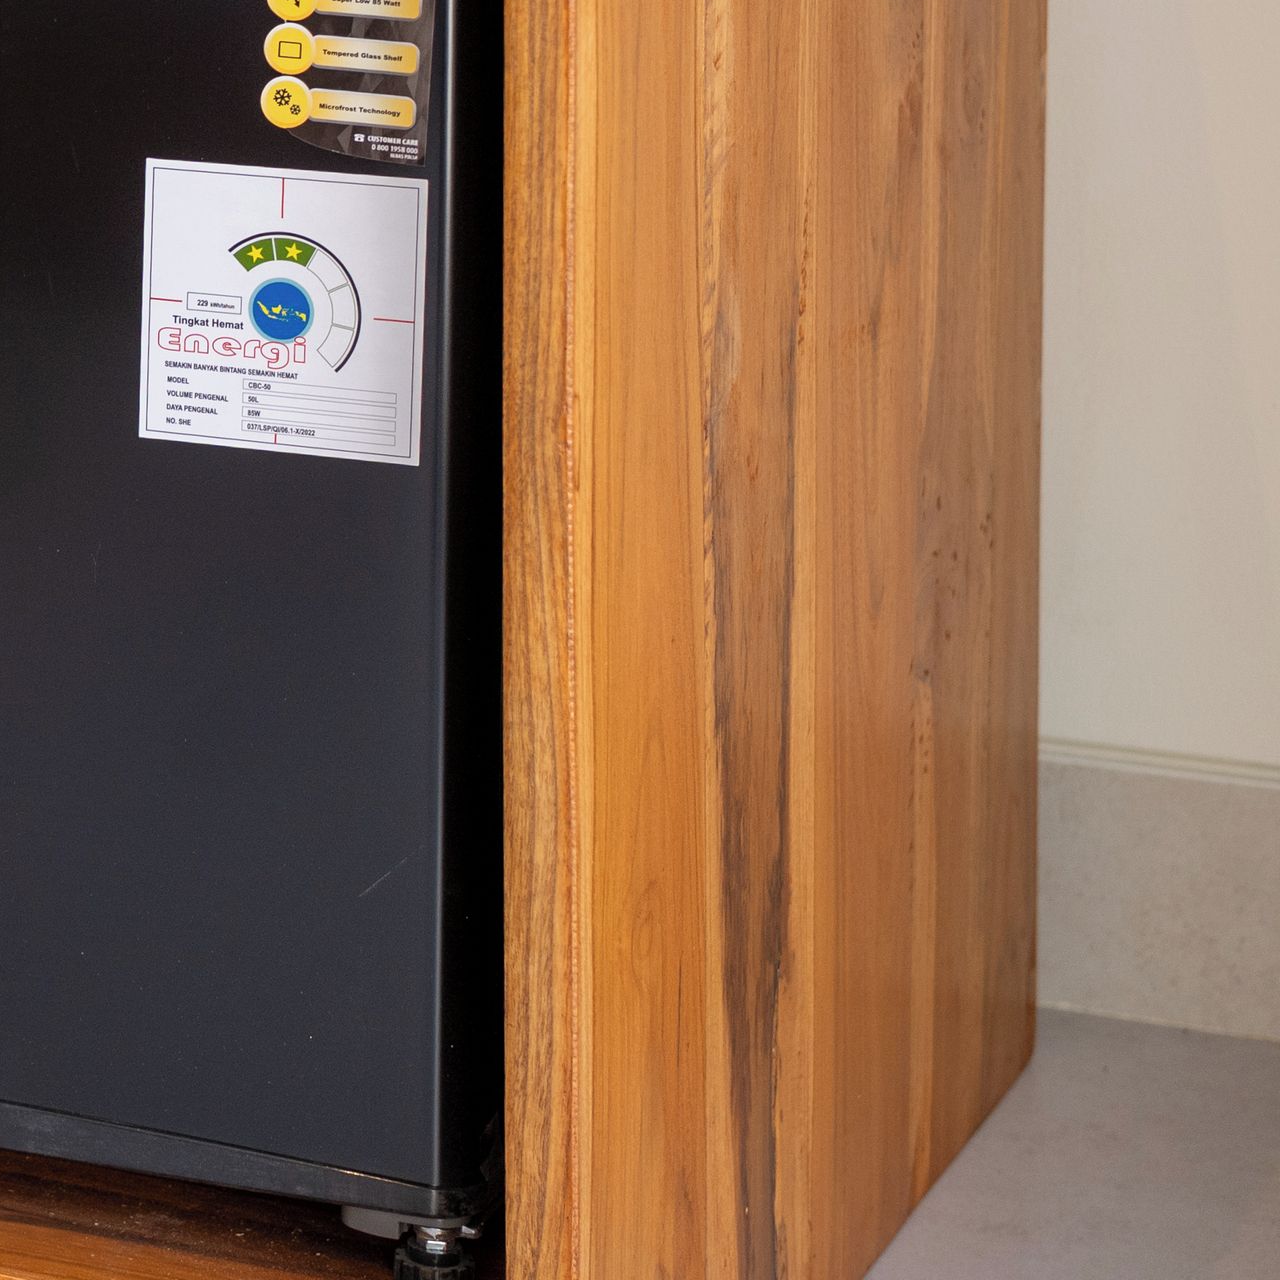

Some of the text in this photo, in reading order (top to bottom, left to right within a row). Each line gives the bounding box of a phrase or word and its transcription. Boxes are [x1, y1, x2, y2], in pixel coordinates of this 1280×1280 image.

[323, 49, 403, 62] Tempered Glass Shelf
[319, 103, 401, 118] Microfrost Technology
[367, 135, 418, 146] CUSTOMER CARE
[377, 144, 389, 152] 800
[197, 299, 208, 307] 229
[172, 315, 244, 330] Tingkat Hemat
[157, 326, 307, 370] Energi
[164, 360, 298, 380] SEMAKIN BANYAK BINTANG SEMAKIN HEMAT
[167, 376, 189, 384] MODEL
[248, 381, 271, 391] CBC-50
[166, 389, 229, 402] VOLUME PENGENAL
[248, 395, 259, 403] 50L
[166, 403, 218, 415] DAYA PENGENAL
[247, 409, 261, 417] 85W
[165, 416, 191, 426] NO. SHE
